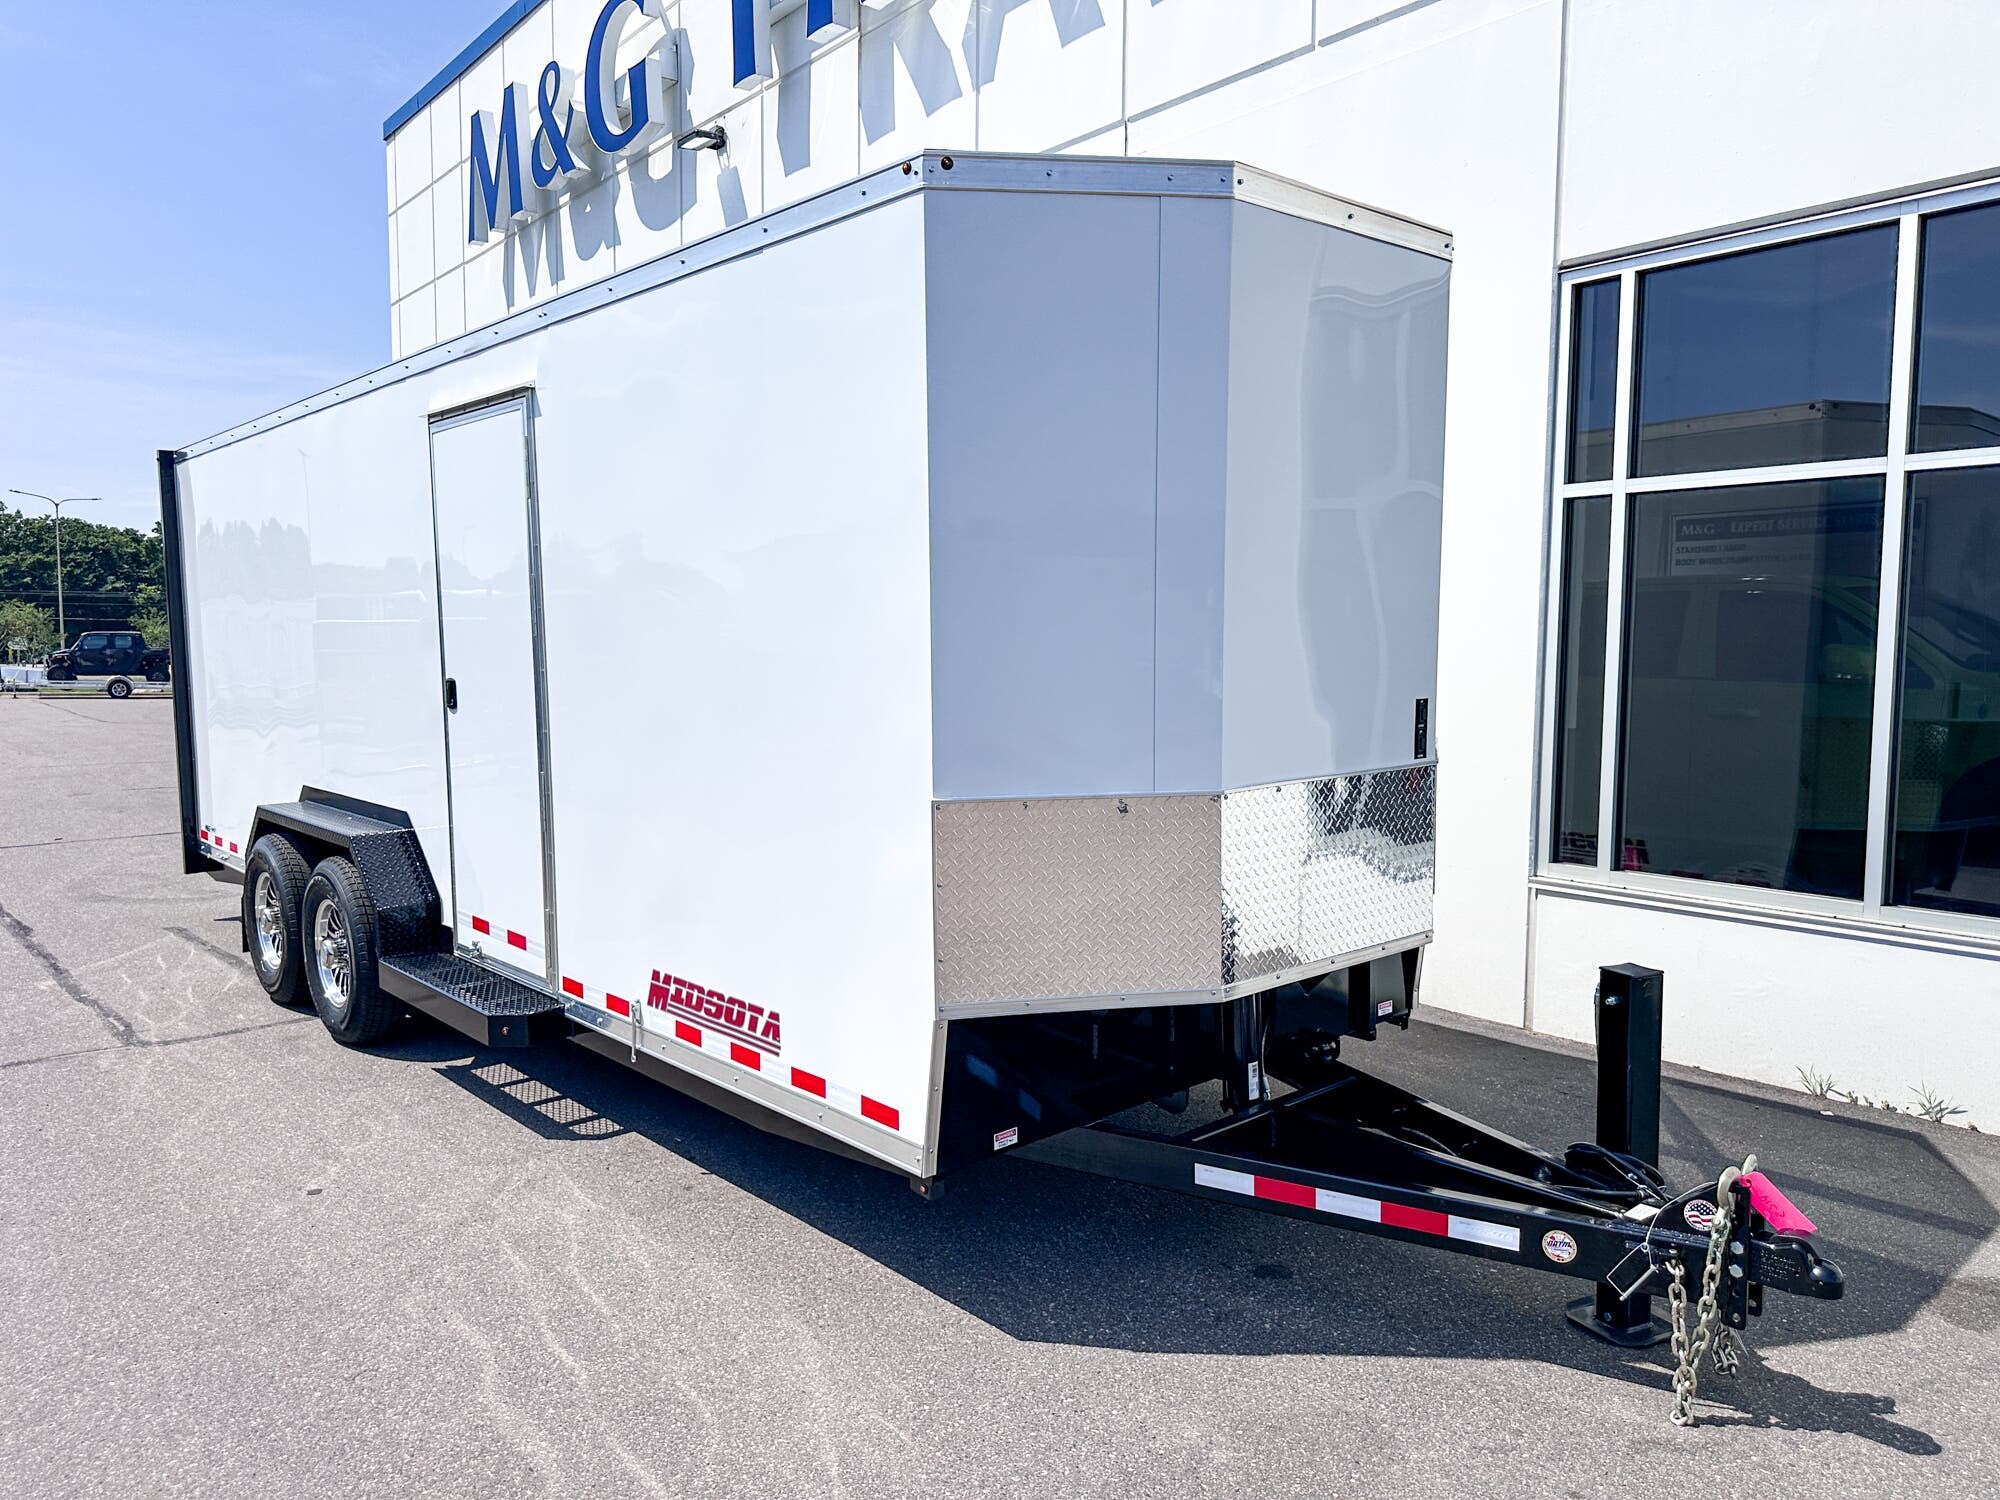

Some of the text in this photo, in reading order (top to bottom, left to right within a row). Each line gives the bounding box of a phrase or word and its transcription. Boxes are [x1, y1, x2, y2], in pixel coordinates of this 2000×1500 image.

[468, 0, 662, 246] M&G
[1680, 523, 1716, 536] M&G
[647, 969, 781, 1043] MIDSOTA
